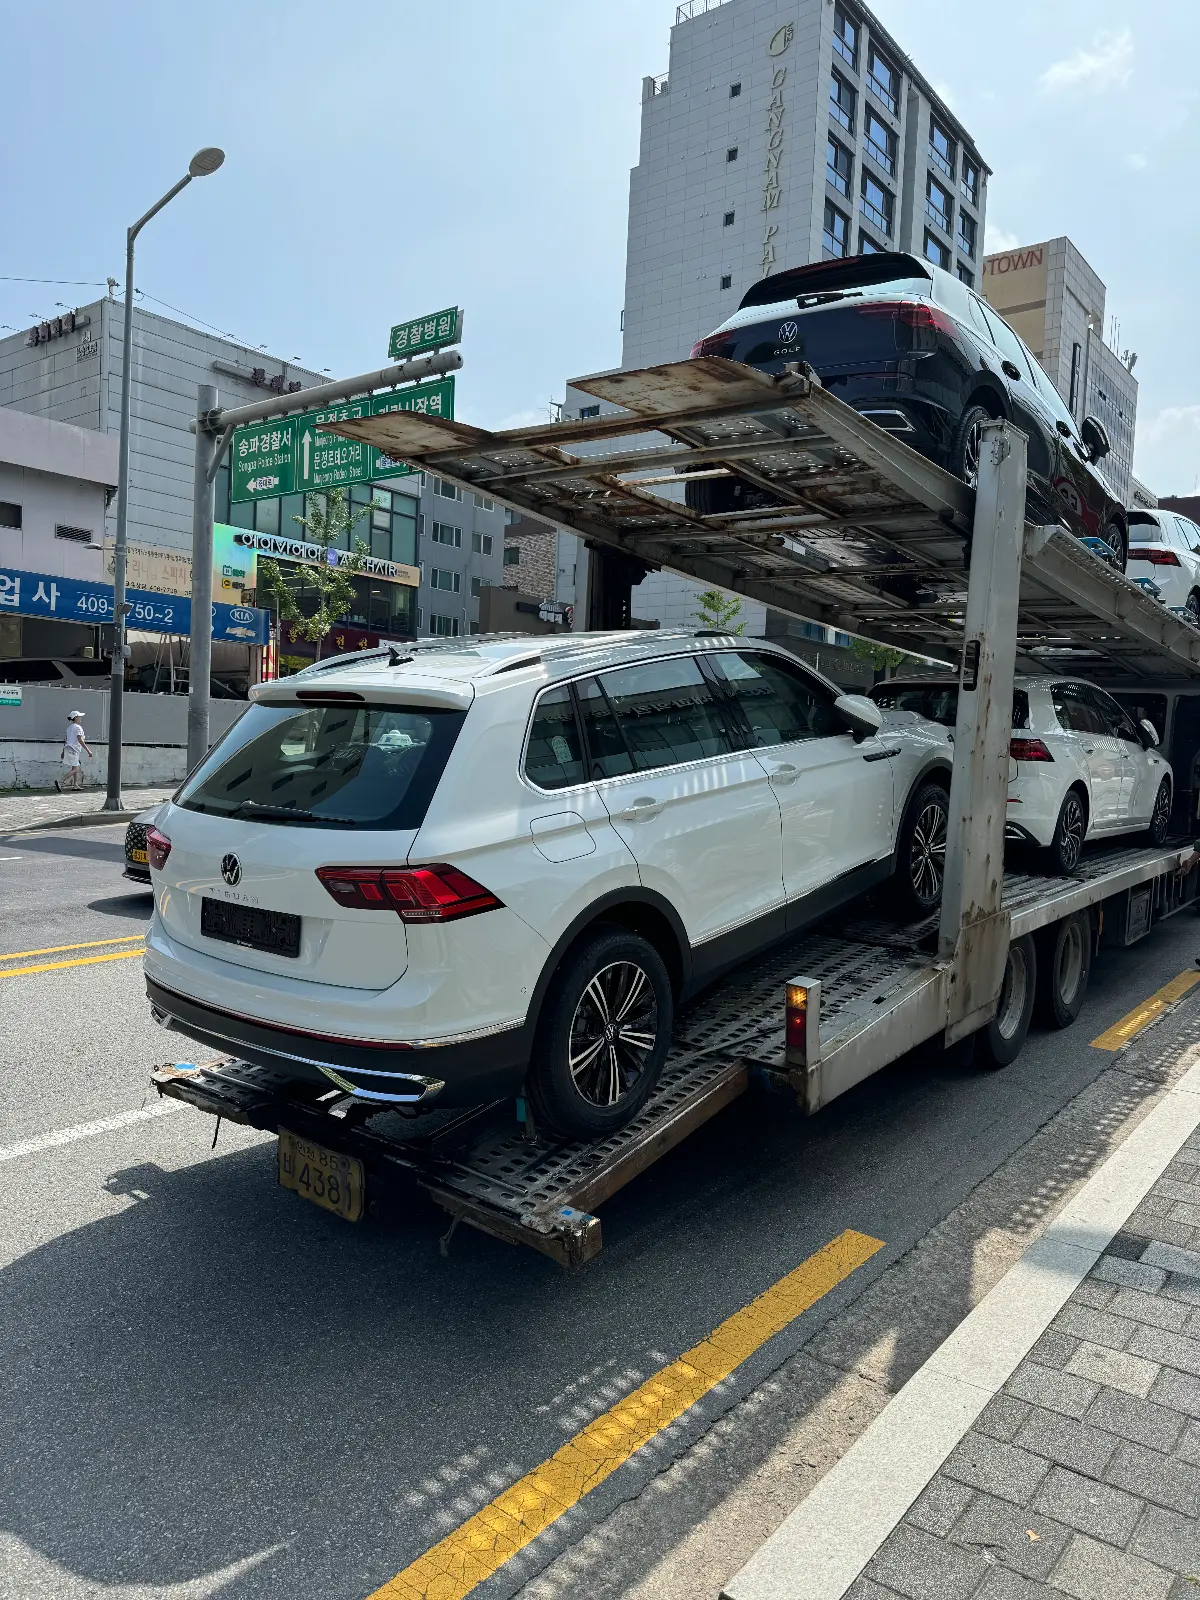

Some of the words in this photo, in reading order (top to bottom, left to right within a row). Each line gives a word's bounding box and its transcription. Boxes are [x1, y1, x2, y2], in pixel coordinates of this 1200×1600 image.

[396, 315, 451, 349] 경찰병원
[773, 346, 801, 356] GOLF
[238, 427, 292, 457] 송파경찰서
[238, 460, 257, 473] Songpa
[257, 457, 273, 469] Police
[161, 564, 187, 586] 스피치
[232, 609, 252, 622] KIA
[297, 1140, 316, 1163] 인천
[319, 1150, 339, 1172] 85
